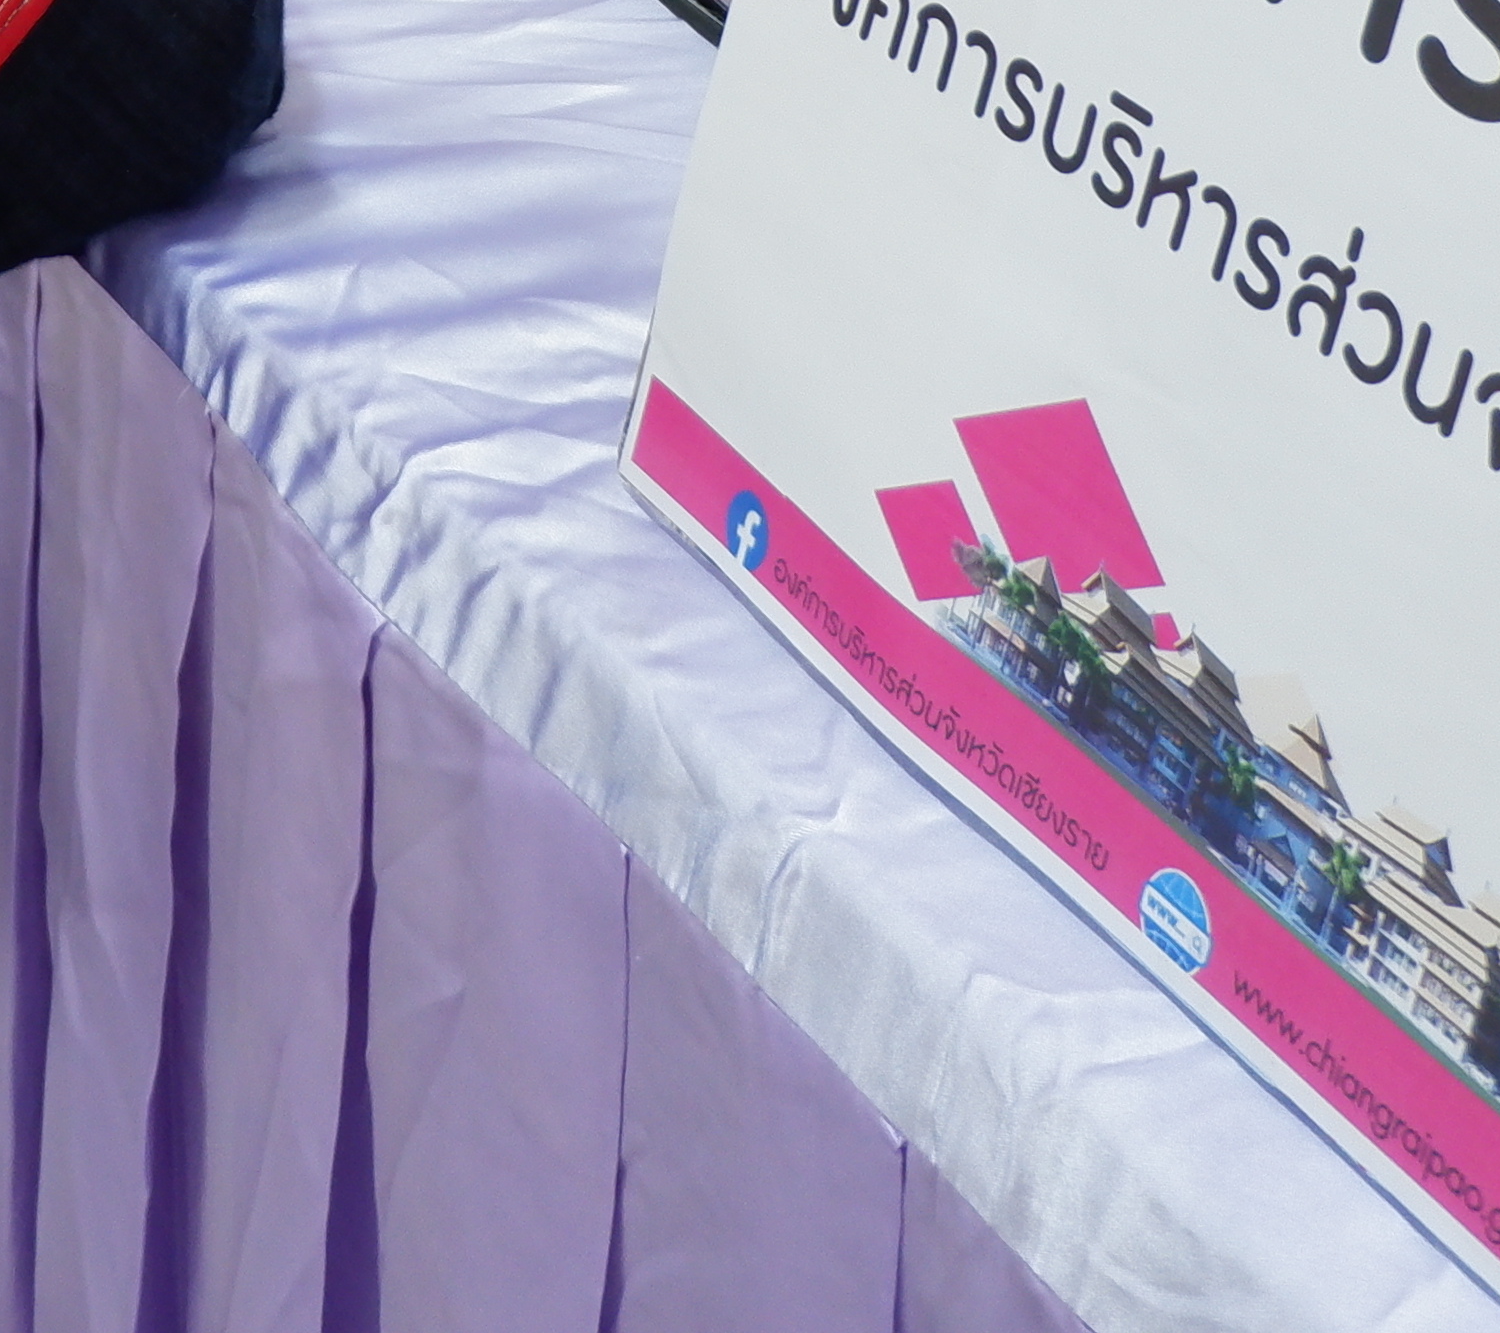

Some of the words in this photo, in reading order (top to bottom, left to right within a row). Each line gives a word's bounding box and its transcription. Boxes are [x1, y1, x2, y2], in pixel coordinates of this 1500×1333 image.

[773, 558, 1110, 871] องค์การบริหารส่วนจังหวัดเชียงราย
